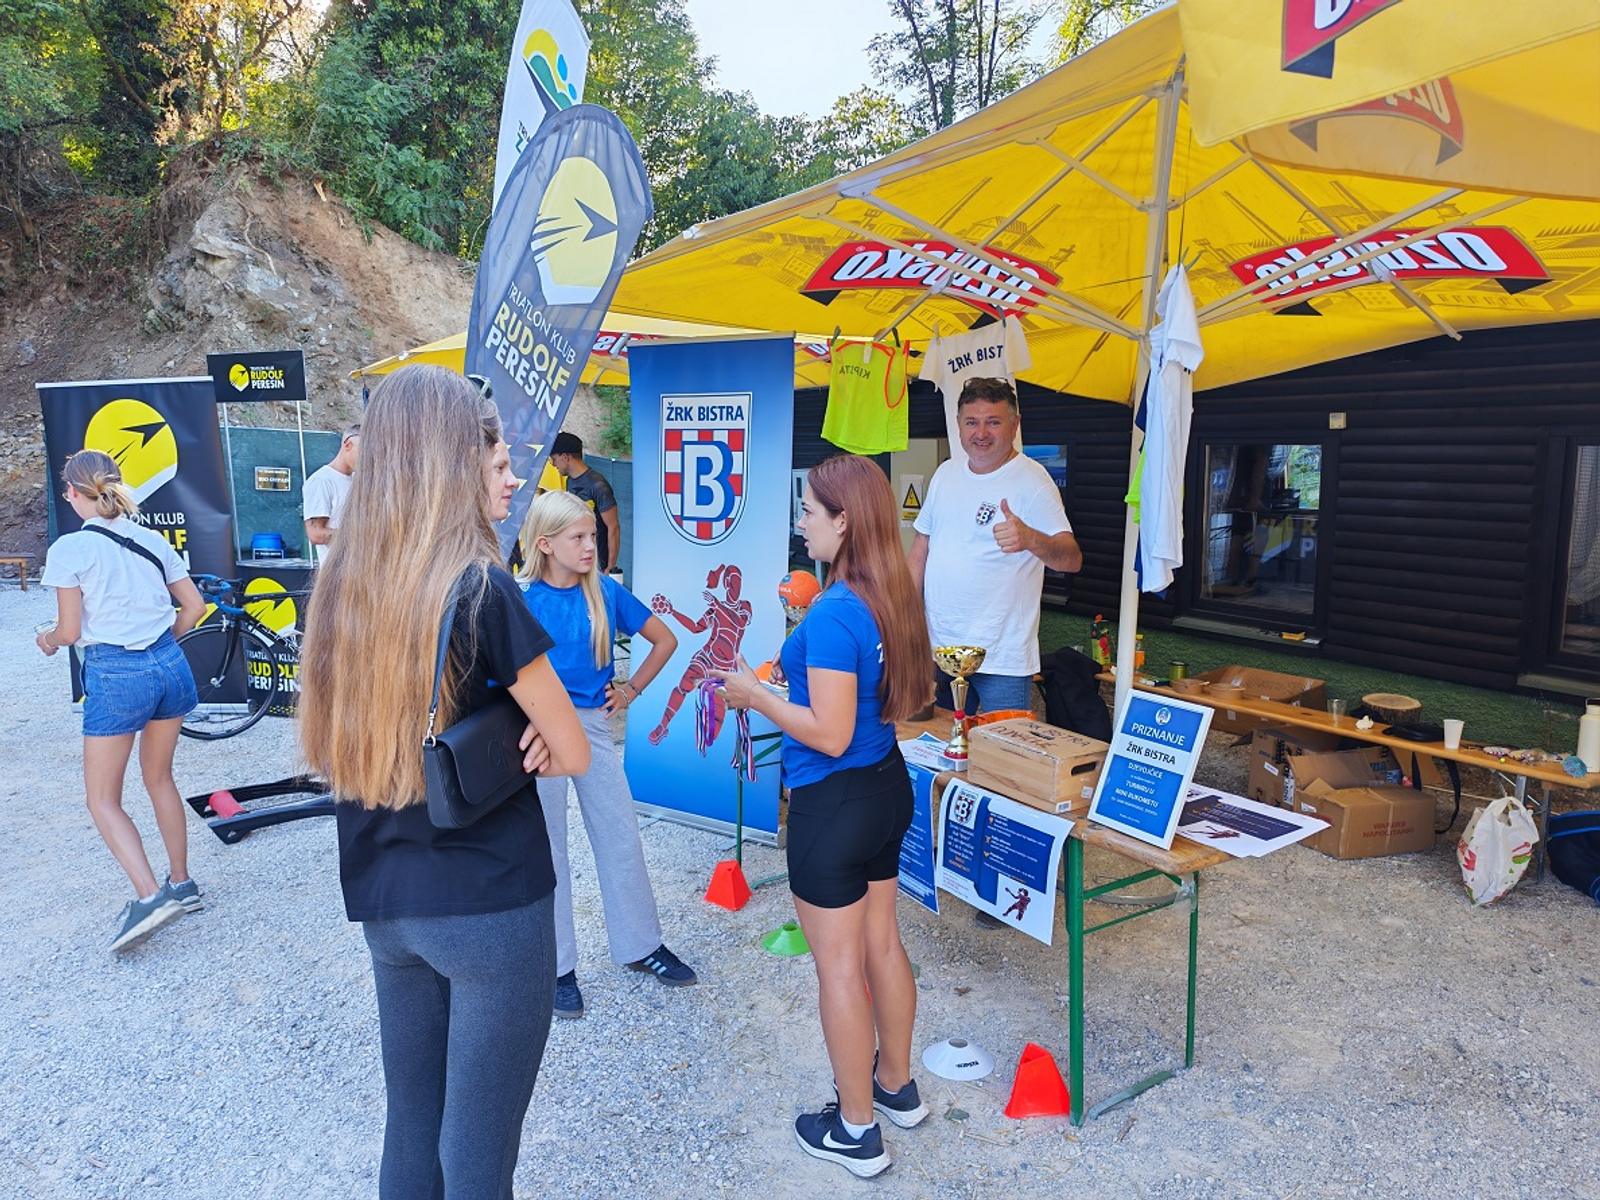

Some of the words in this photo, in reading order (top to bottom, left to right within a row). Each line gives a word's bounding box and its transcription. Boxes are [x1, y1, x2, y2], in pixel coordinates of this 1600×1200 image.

[507, 281, 552, 337] TRIATLON
[550, 330, 576, 365] KLUB
[494, 301, 571, 392] RUDOLF
[250, 369, 284, 380] RUDOLF
[947, 352, 974, 374] ŽRK
[666, 401, 694, 422] ŽRK
[697, 405, 745, 422] BISTRA
[682, 441, 735, 522] B
[154, 512, 186, 525] KLUB
[1131, 722, 1186, 746] PRIZNANJE
[1125, 741, 1143, 756] ŽRK
[1143, 747, 1176, 765] BISTRA
